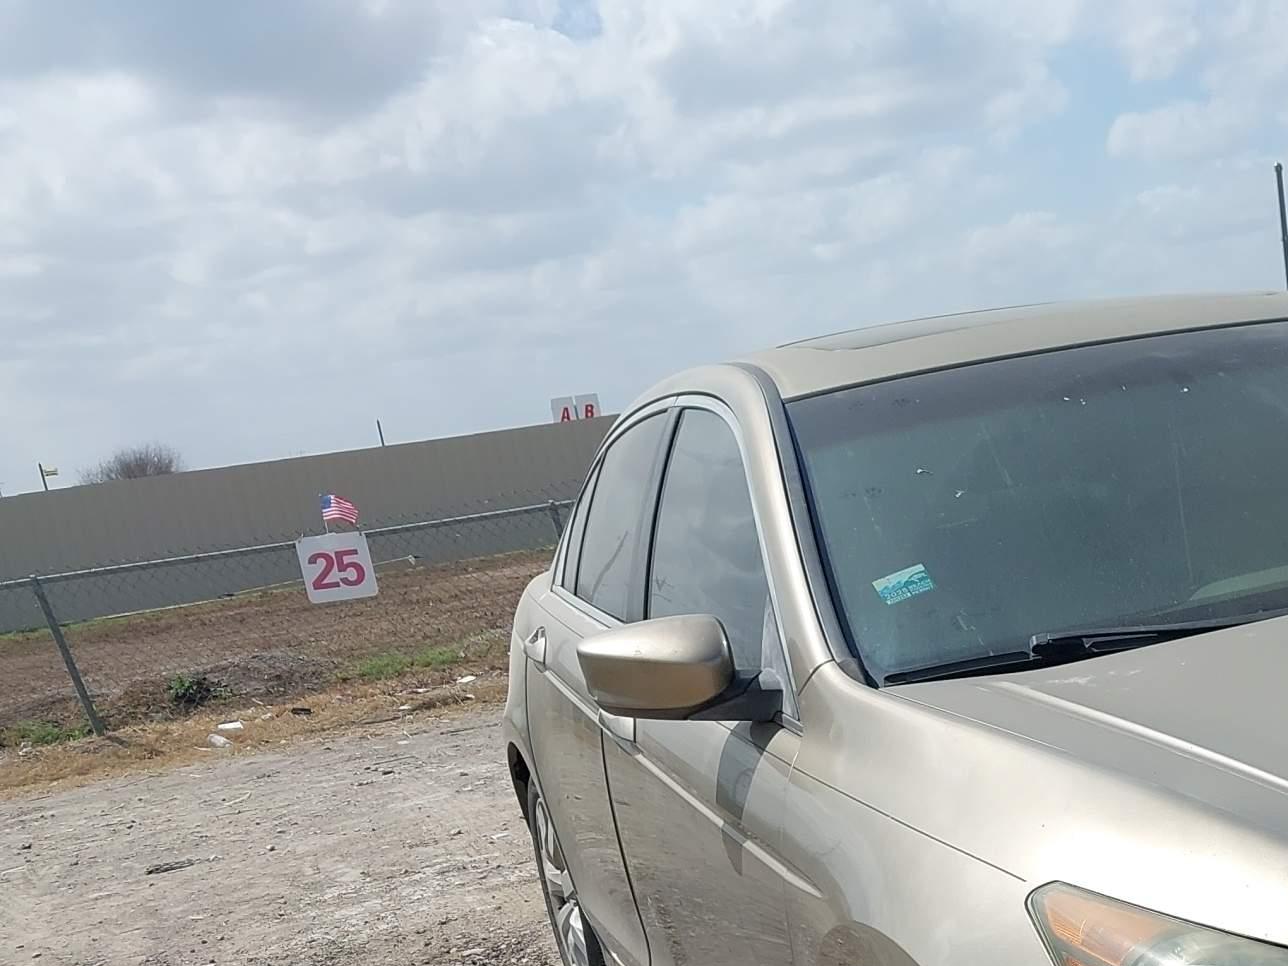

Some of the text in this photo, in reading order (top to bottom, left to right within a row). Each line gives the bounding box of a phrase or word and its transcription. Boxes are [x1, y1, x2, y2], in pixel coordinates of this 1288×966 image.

[561, 404, 594, 422] A B
[308, 549, 365, 590] 25
